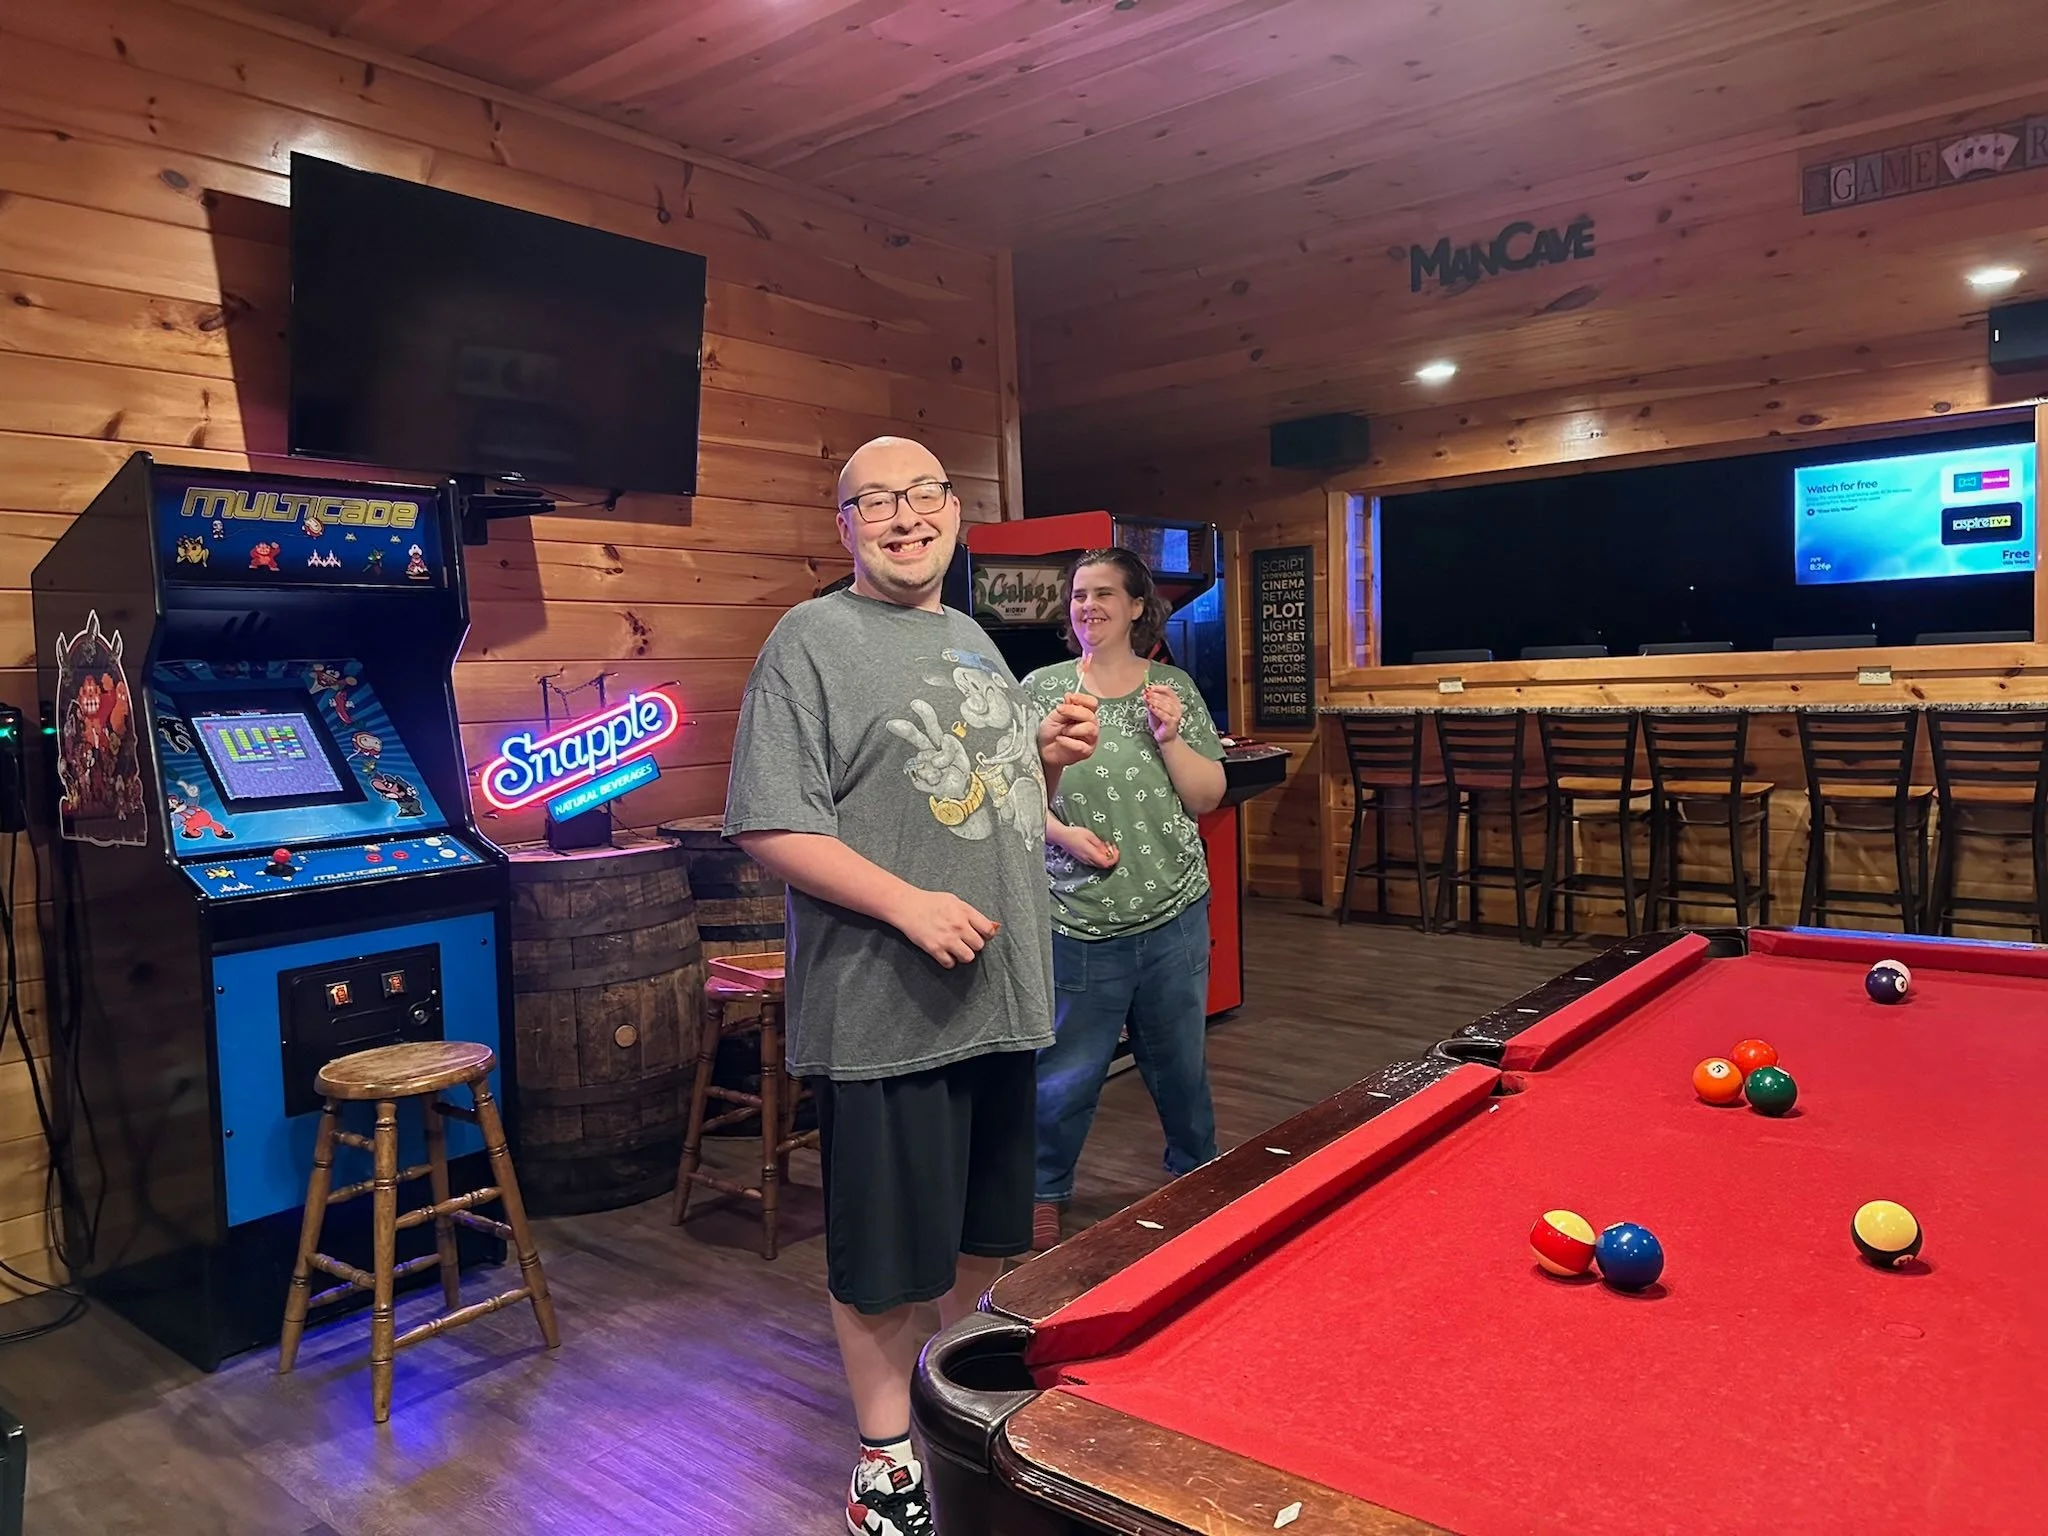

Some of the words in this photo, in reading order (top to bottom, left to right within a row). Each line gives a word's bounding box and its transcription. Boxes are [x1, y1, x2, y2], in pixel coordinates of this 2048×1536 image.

[1833, 150, 1932, 201] GAME
[1806, 483, 1838, 494] Watch
[1840, 481, 1855, 491] for
[1857, 480, 1878, 490] free
[2002, 550, 2031, 559] Free
[1262, 557, 1304, 572] SCRIPT
[1262, 578, 1305, 590] CINEMA
[988, 571, 1059, 619] Galaga
[1262, 590, 1304, 601] RETAKE
[1263, 602, 1305, 619] PLOT
[1263, 619, 1305, 632] LIGHTS
[1263, 633, 1285, 643] HOT
[1287, 632, 1305, 642] SET
[1263, 643, 1305, 654] COMEDY
[1263, 653, 1306, 663] DIRECTOR
[1264, 663, 1306, 674] ACTORS
[1264, 676, 1307, 684] ANIMATION
[1264, 692, 1307, 704] MOVIES
[1264, 705, 1307, 714] PREMIERE
[494, 693, 663, 796] Snapple
[554, 789, 599, 816] NATURAL
[600, 763, 653, 796] BEVERAGES
